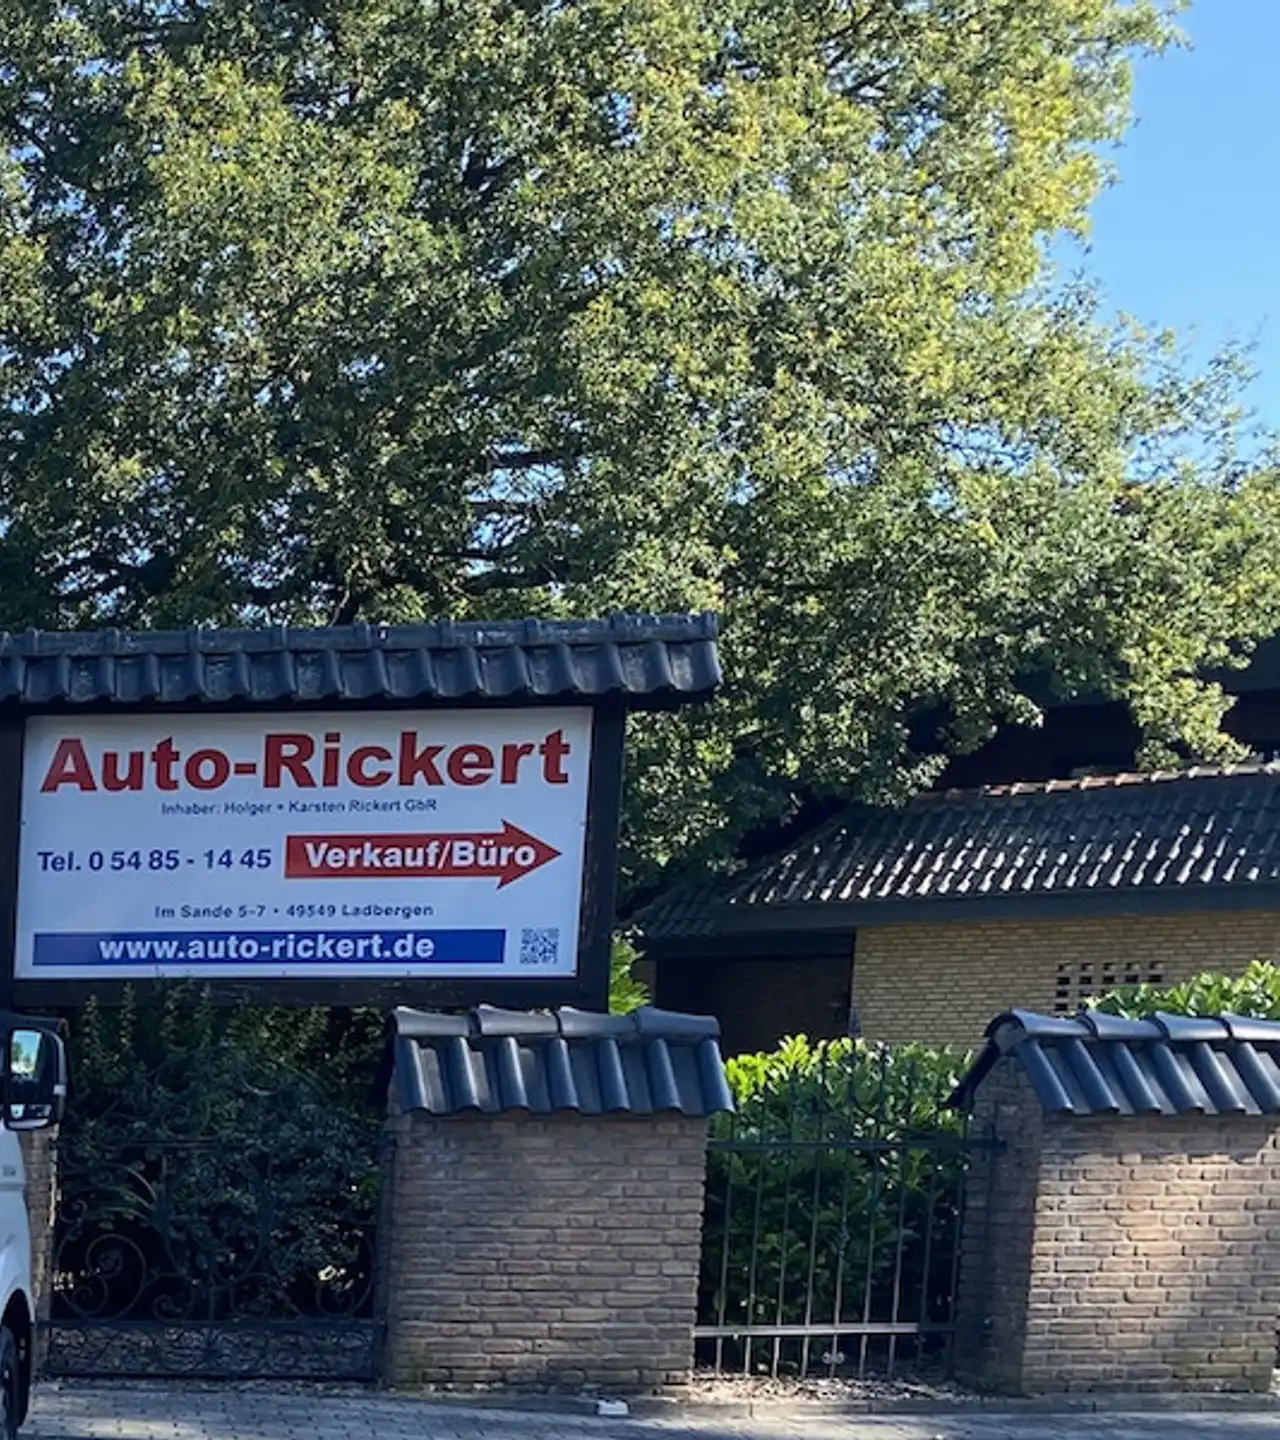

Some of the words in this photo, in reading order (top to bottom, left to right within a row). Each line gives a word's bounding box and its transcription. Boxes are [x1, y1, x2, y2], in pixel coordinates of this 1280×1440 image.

[40, 729, 571, 793] Auto-Rickert
[161, 802, 220, 815] Inhaber:
[224, 801, 272, 816] Holger
[288, 800, 345, 813] Karsten
[348, 800, 401, 813] Rickert
[404, 799, 438, 812] GbR
[37, 851, 81, 872] Tel.
[303, 841, 537, 871] Verkauf/Büro
[154, 905, 175, 918] Im
[180, 904, 233, 918] Sande
[238, 904, 266, 918] 5-7
[286, 904, 336, 917] 49549
[341, 903, 434, 919] Ladbergen
[99, 933, 436, 961] www.auto-rickert.de
